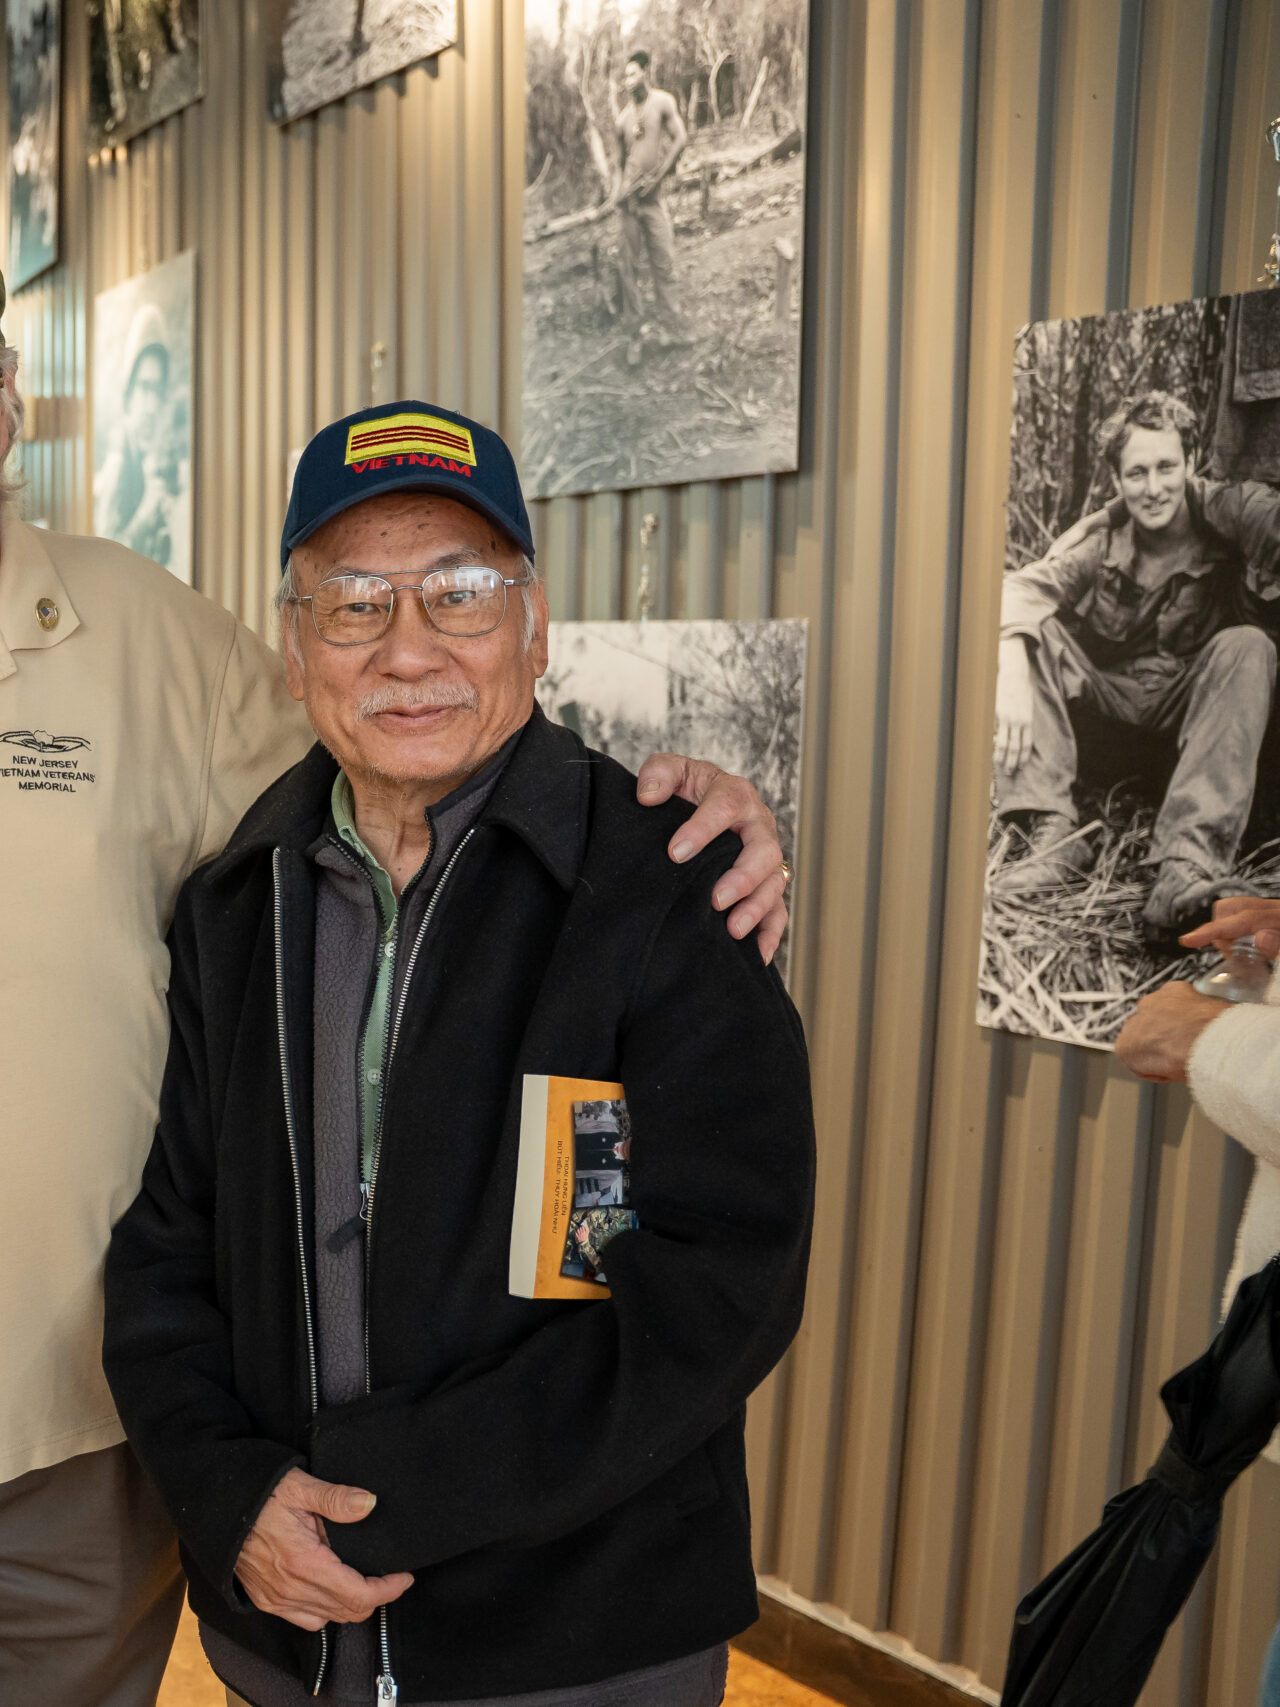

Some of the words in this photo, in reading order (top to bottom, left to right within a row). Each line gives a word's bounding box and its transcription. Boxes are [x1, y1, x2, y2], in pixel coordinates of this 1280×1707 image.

[350, 453, 472, 478] VIETNAM
[12, 755, 37, 765] NEW
[39, 759, 79, 769] JERSEY
[18, 781, 77, 793] MEMORIAL
